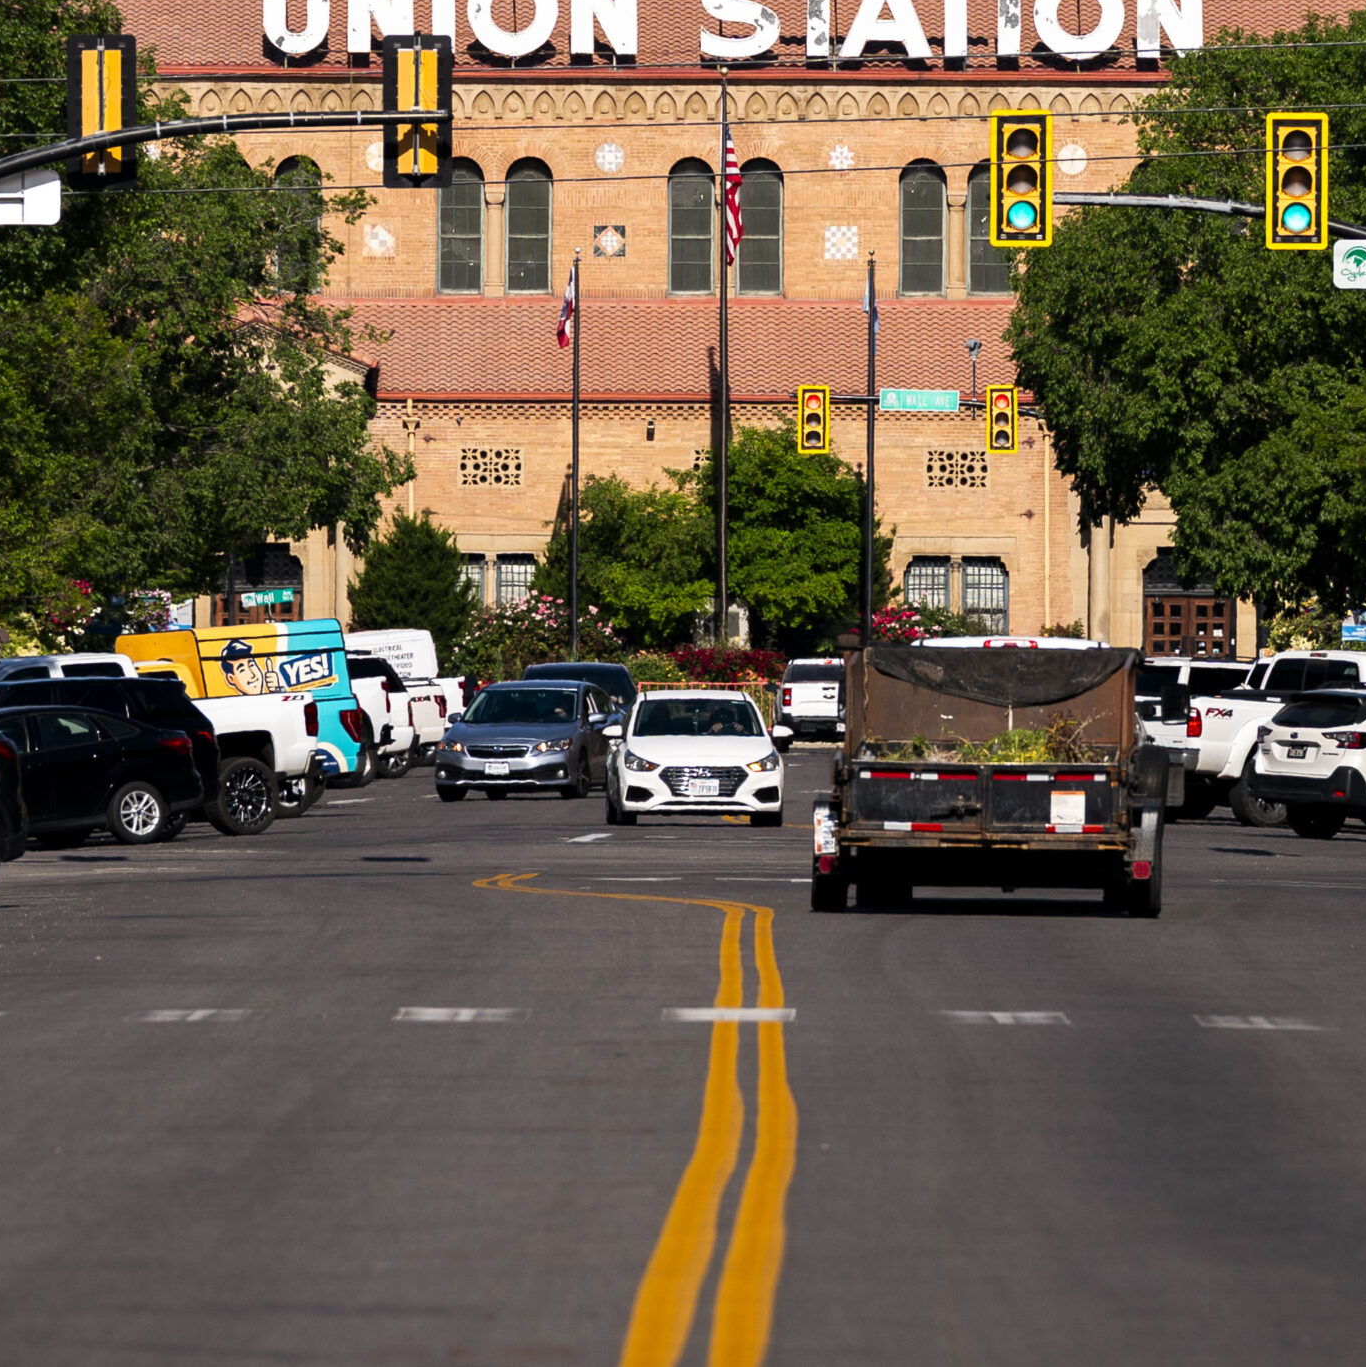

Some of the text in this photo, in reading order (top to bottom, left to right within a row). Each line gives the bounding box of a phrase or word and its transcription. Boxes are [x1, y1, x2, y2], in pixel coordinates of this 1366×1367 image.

[905, 393, 929, 407] WALL
[256, 592, 274, 604] Wall
[373, 644, 402, 654] ELECTRICAL
[391, 652, 414, 660] THEATER
[283, 652, 329, 685] YES!
[1205, 707, 1233, 717] FX4
